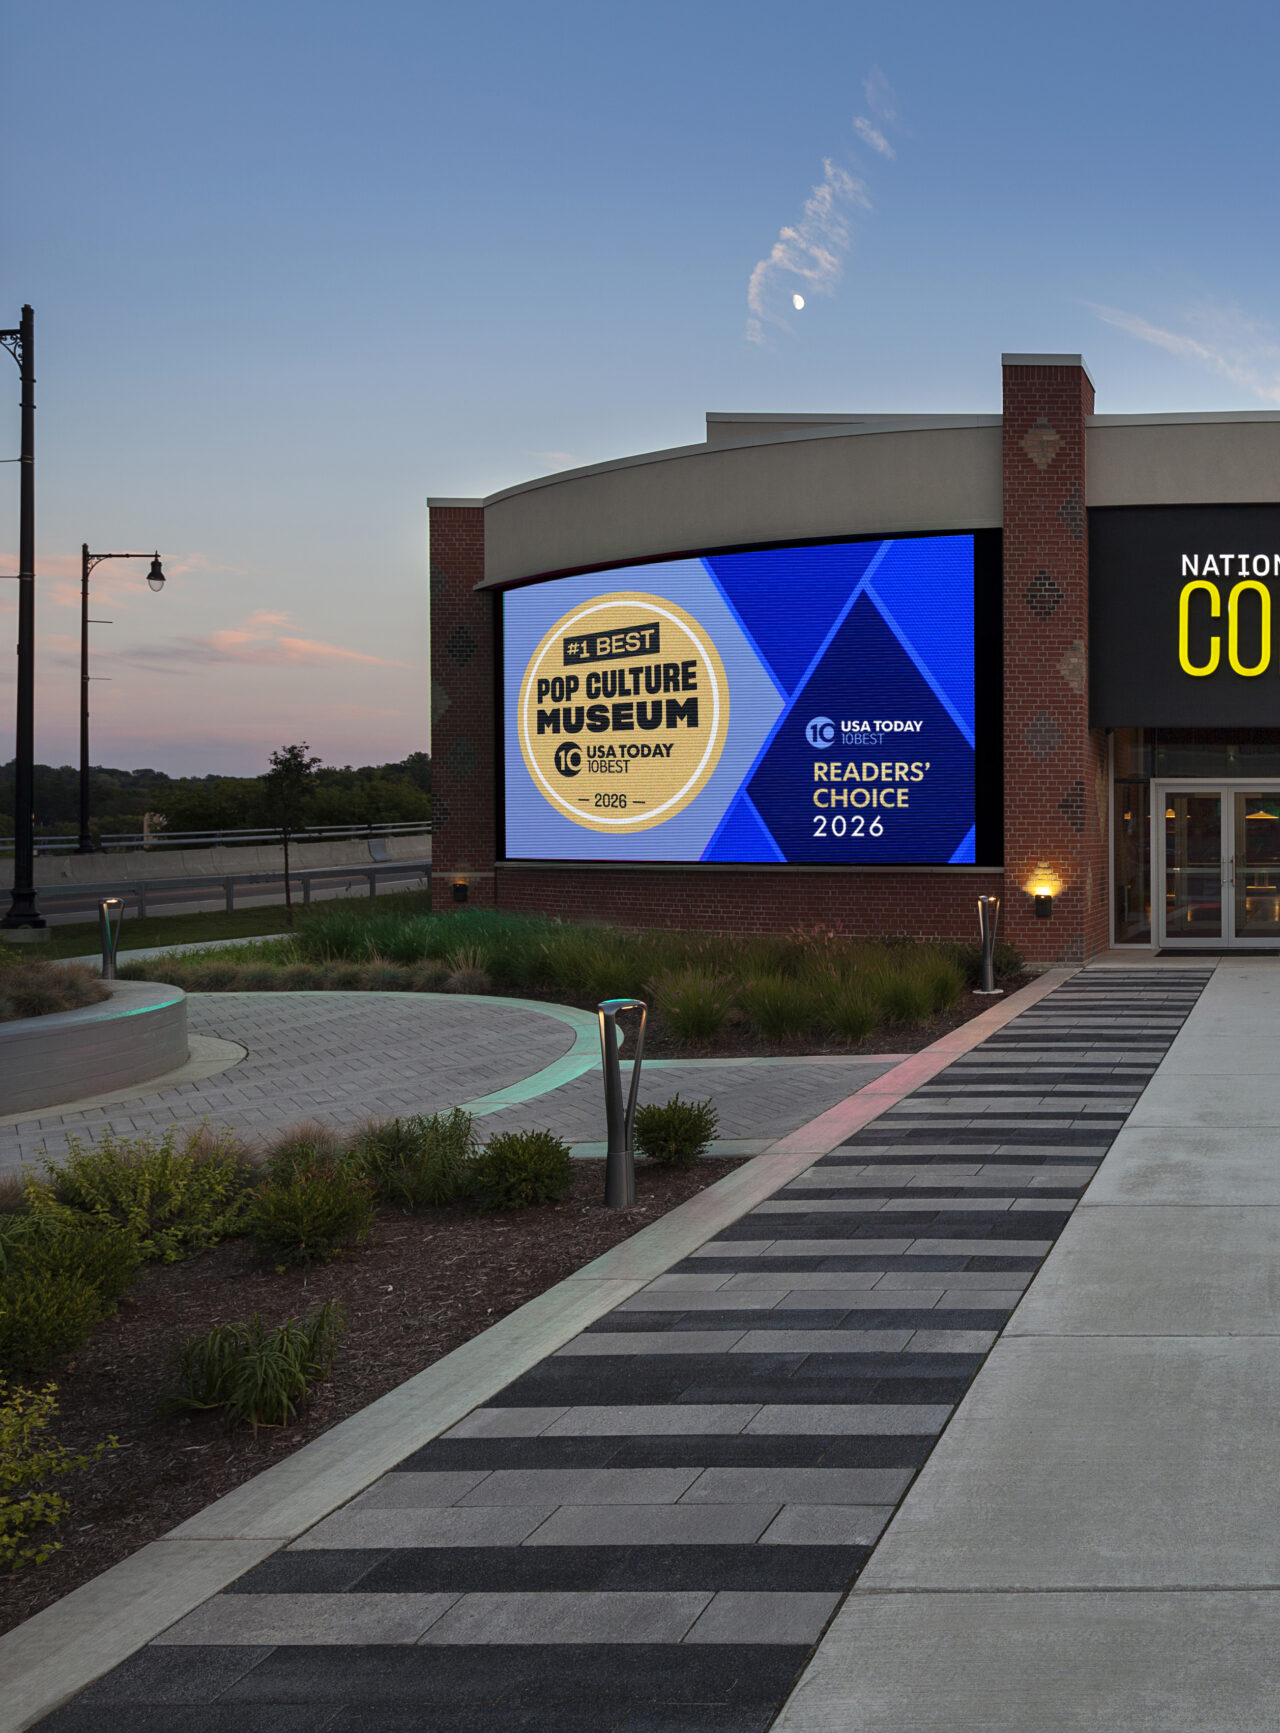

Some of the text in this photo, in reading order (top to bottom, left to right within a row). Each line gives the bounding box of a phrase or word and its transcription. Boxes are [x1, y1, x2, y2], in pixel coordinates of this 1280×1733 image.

[566, 629, 655, 659] #1 BEST
[537, 659, 698, 704] POP CULTURE
[536, 697, 699, 735] MUSEUM
[841, 720, 923, 732] USA TODAY
[841, 732, 885, 745] 10BEST
[587, 743, 675, 759] USA TODAY
[587, 759, 631, 774] 10BEST
[813, 762, 930, 782] READERS'
[594, 792, 627, 809] 2026
[813, 788, 909, 808] CHOICE
[813, 814, 884, 837] 2026
